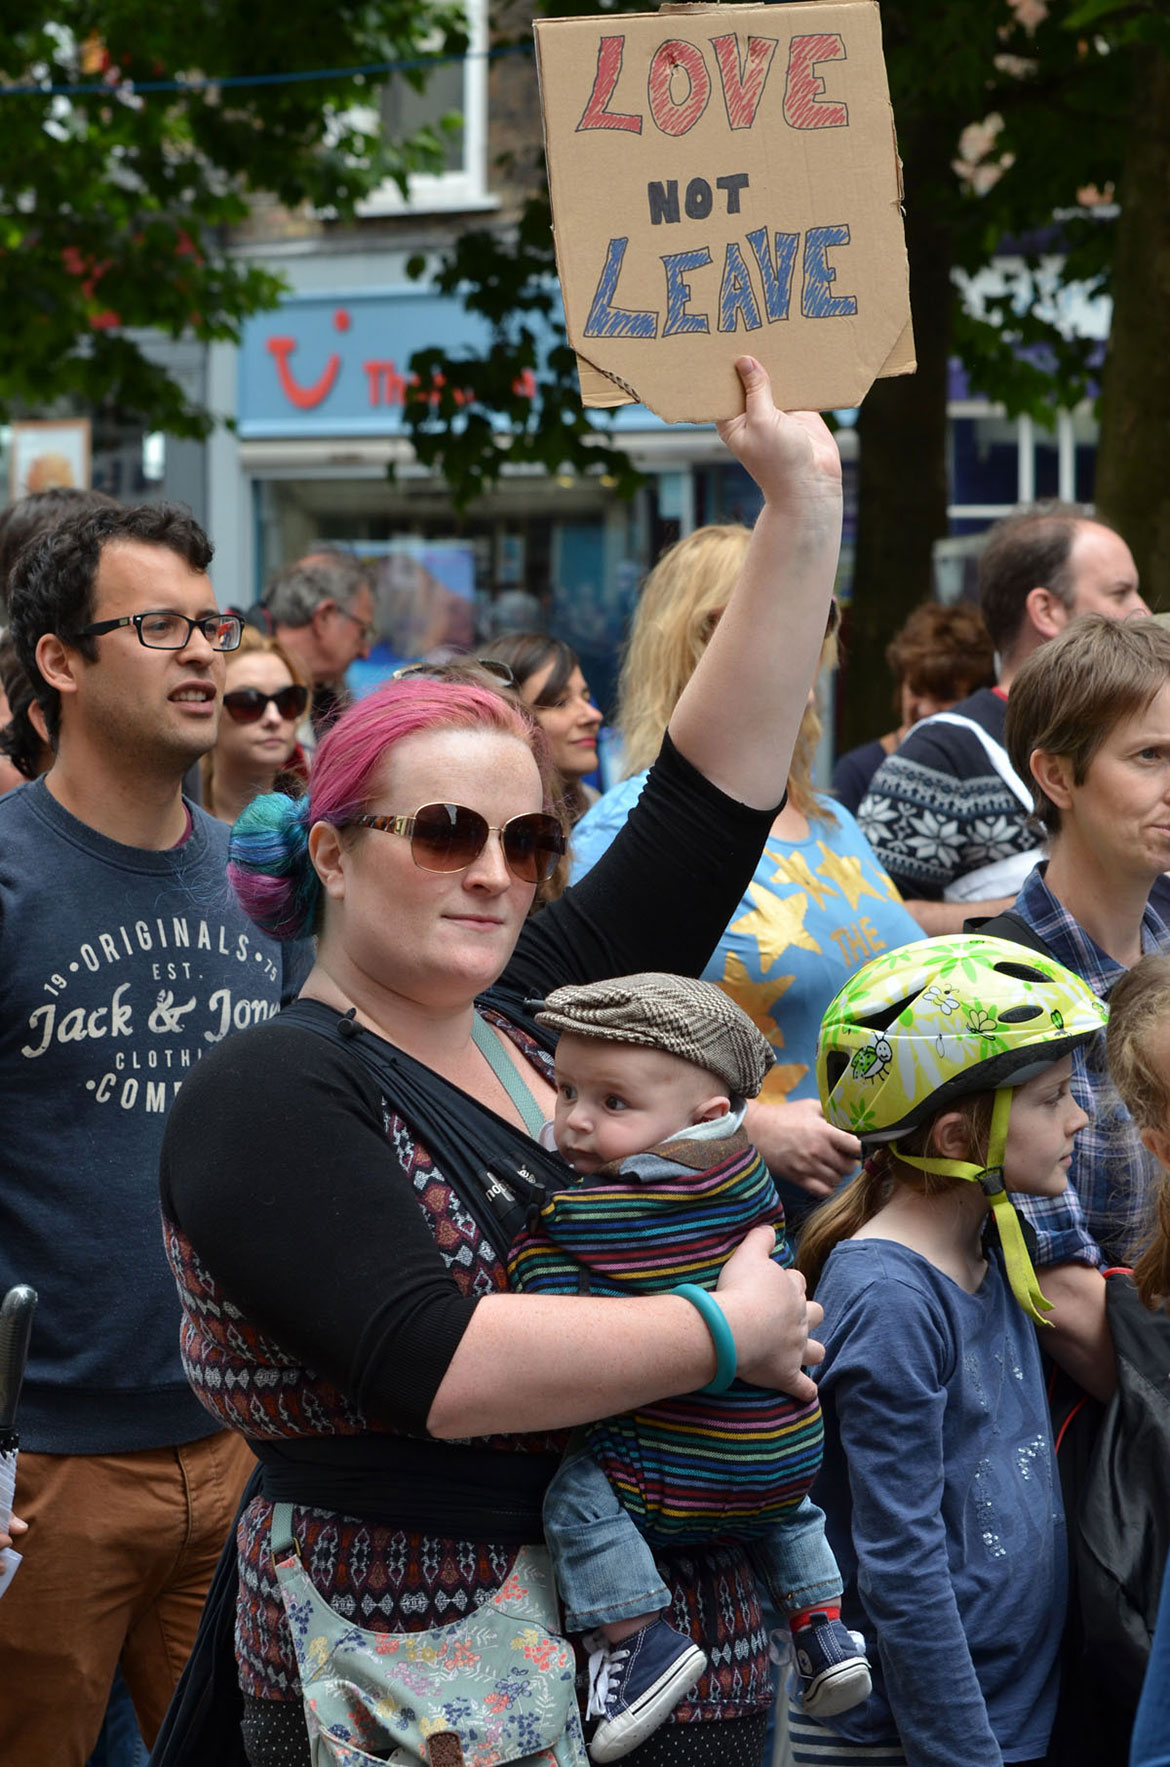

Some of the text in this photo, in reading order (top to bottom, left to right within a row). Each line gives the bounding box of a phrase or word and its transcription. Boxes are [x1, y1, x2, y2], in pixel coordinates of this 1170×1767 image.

[575, 32, 850, 137] LOVE
[647, 173, 750, 225] NOT
[583, 224, 858, 339] LEAVE
[44, 917, 278, 997] 19 ORIGINALS 75
[829, 916, 888, 968] THE
[21, 982, 134, 1059] Jack
[148, 989, 197, 1033] &
[95, 1072, 183, 1114] COM
